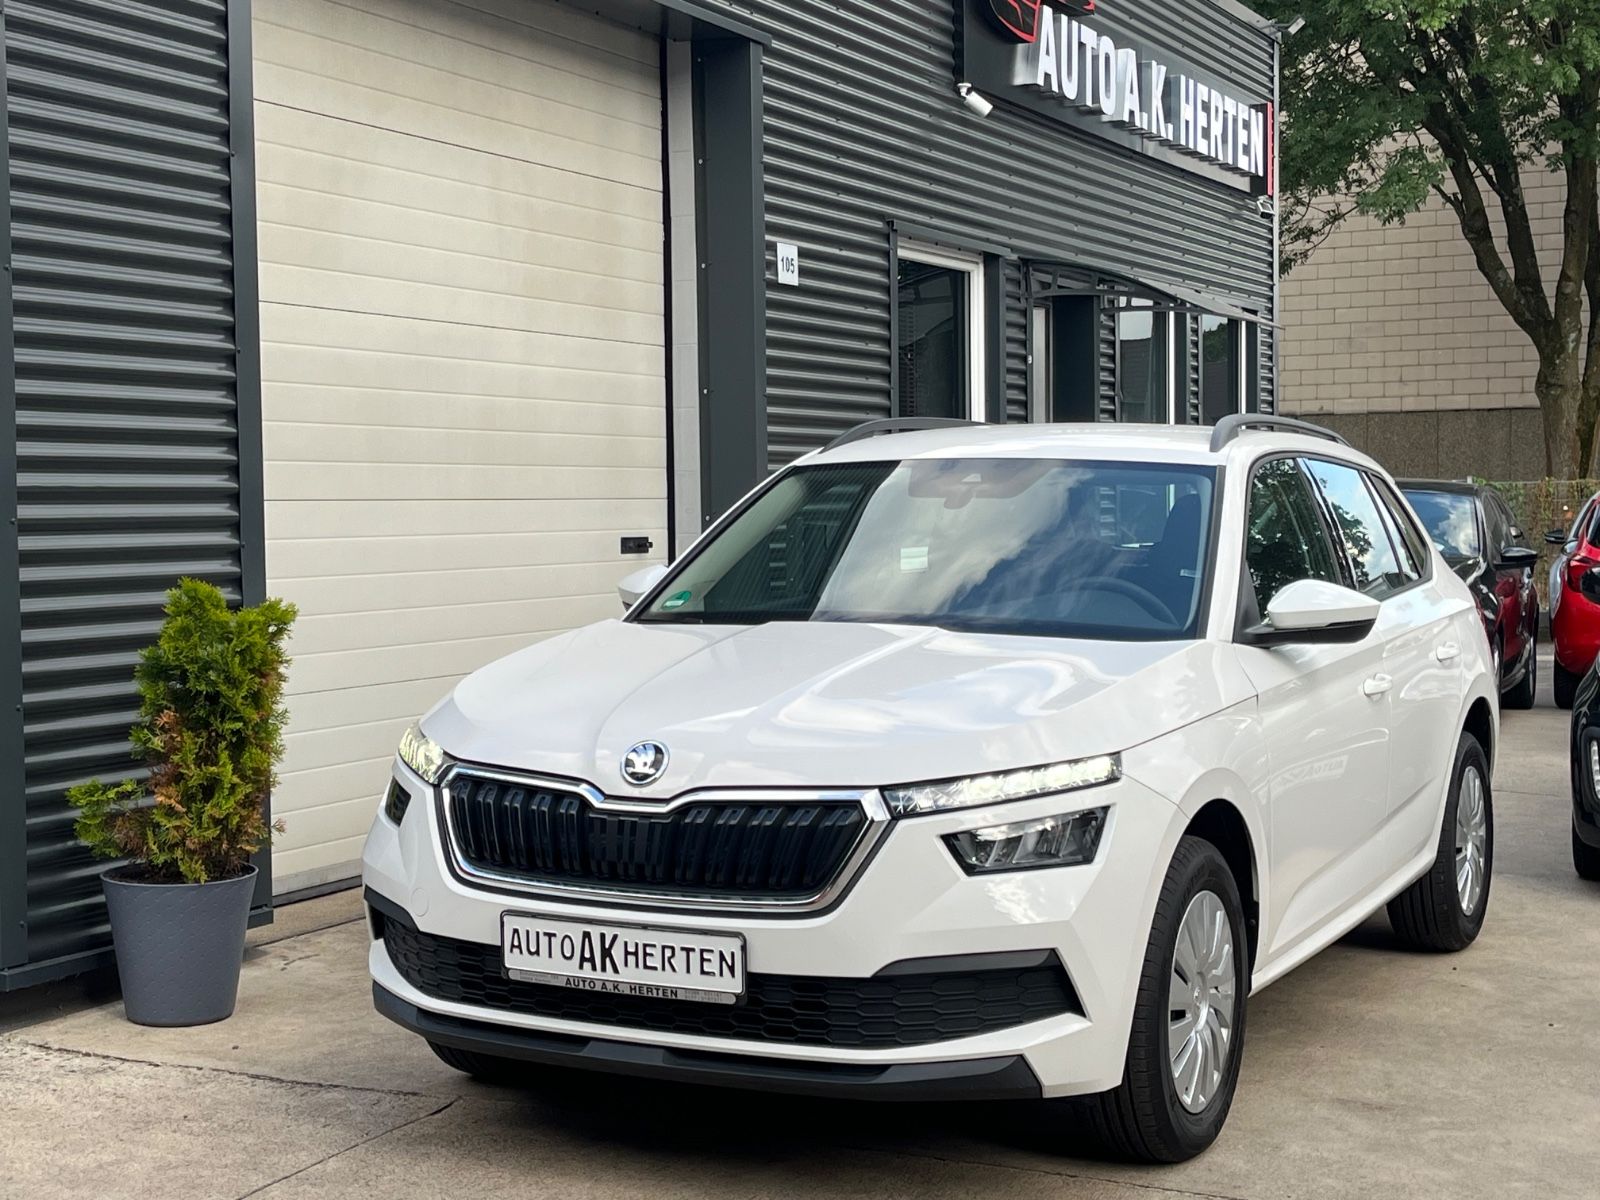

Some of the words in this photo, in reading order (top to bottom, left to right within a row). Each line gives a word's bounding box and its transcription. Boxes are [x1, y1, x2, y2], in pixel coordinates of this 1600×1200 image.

[1036, 4, 1116, 116] AUTO
[1179, 74, 1264, 177] HERTEN
[781, 256, 795, 274] 105
[565, 977, 596, 990] AUTO
[601, 983, 624, 993] A.K.
[629, 986, 678, 999] HERTEN
